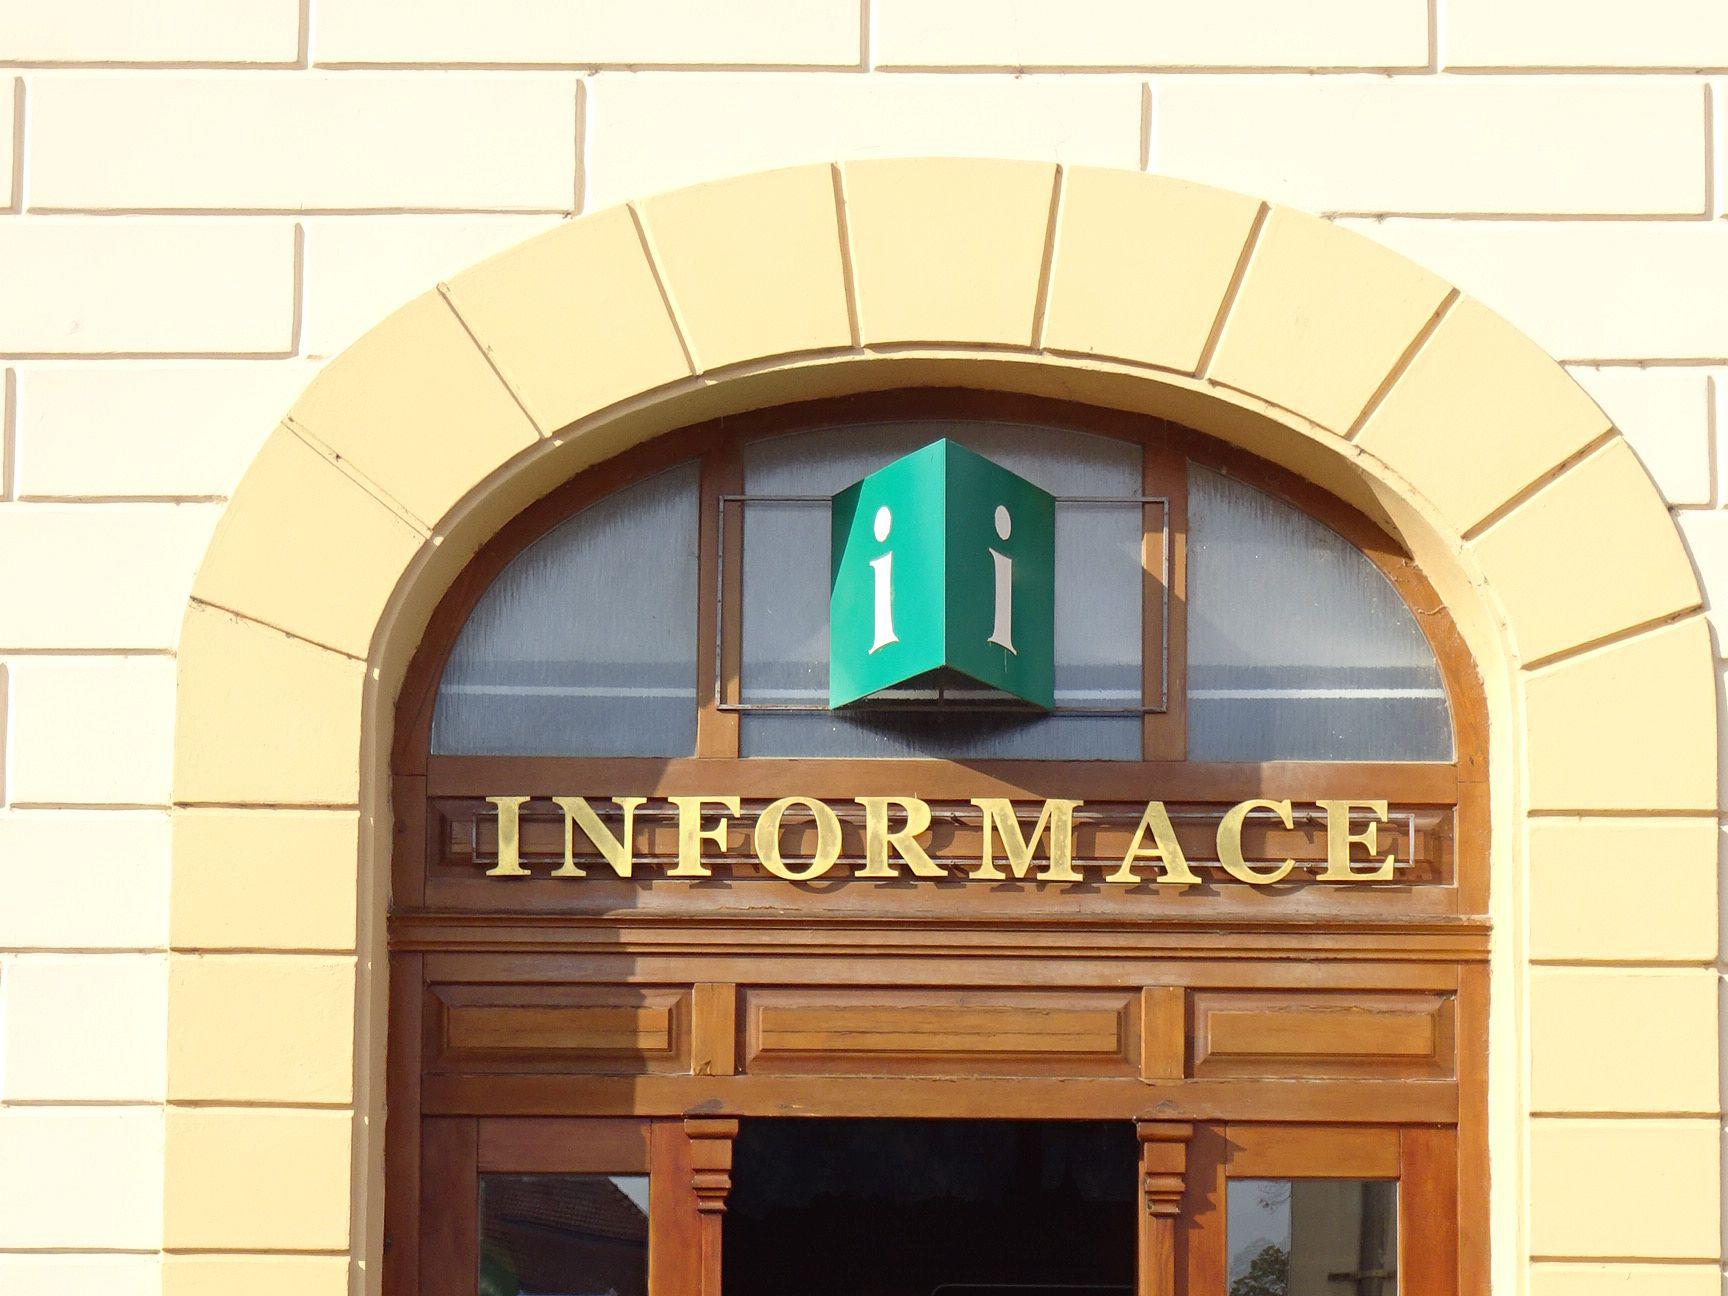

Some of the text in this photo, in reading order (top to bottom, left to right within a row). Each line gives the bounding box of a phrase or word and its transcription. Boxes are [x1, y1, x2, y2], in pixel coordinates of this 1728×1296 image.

[868, 506, 900, 655] i
[987, 505, 1018, 656] i
[485, 794, 1397, 885] INFORMACE
